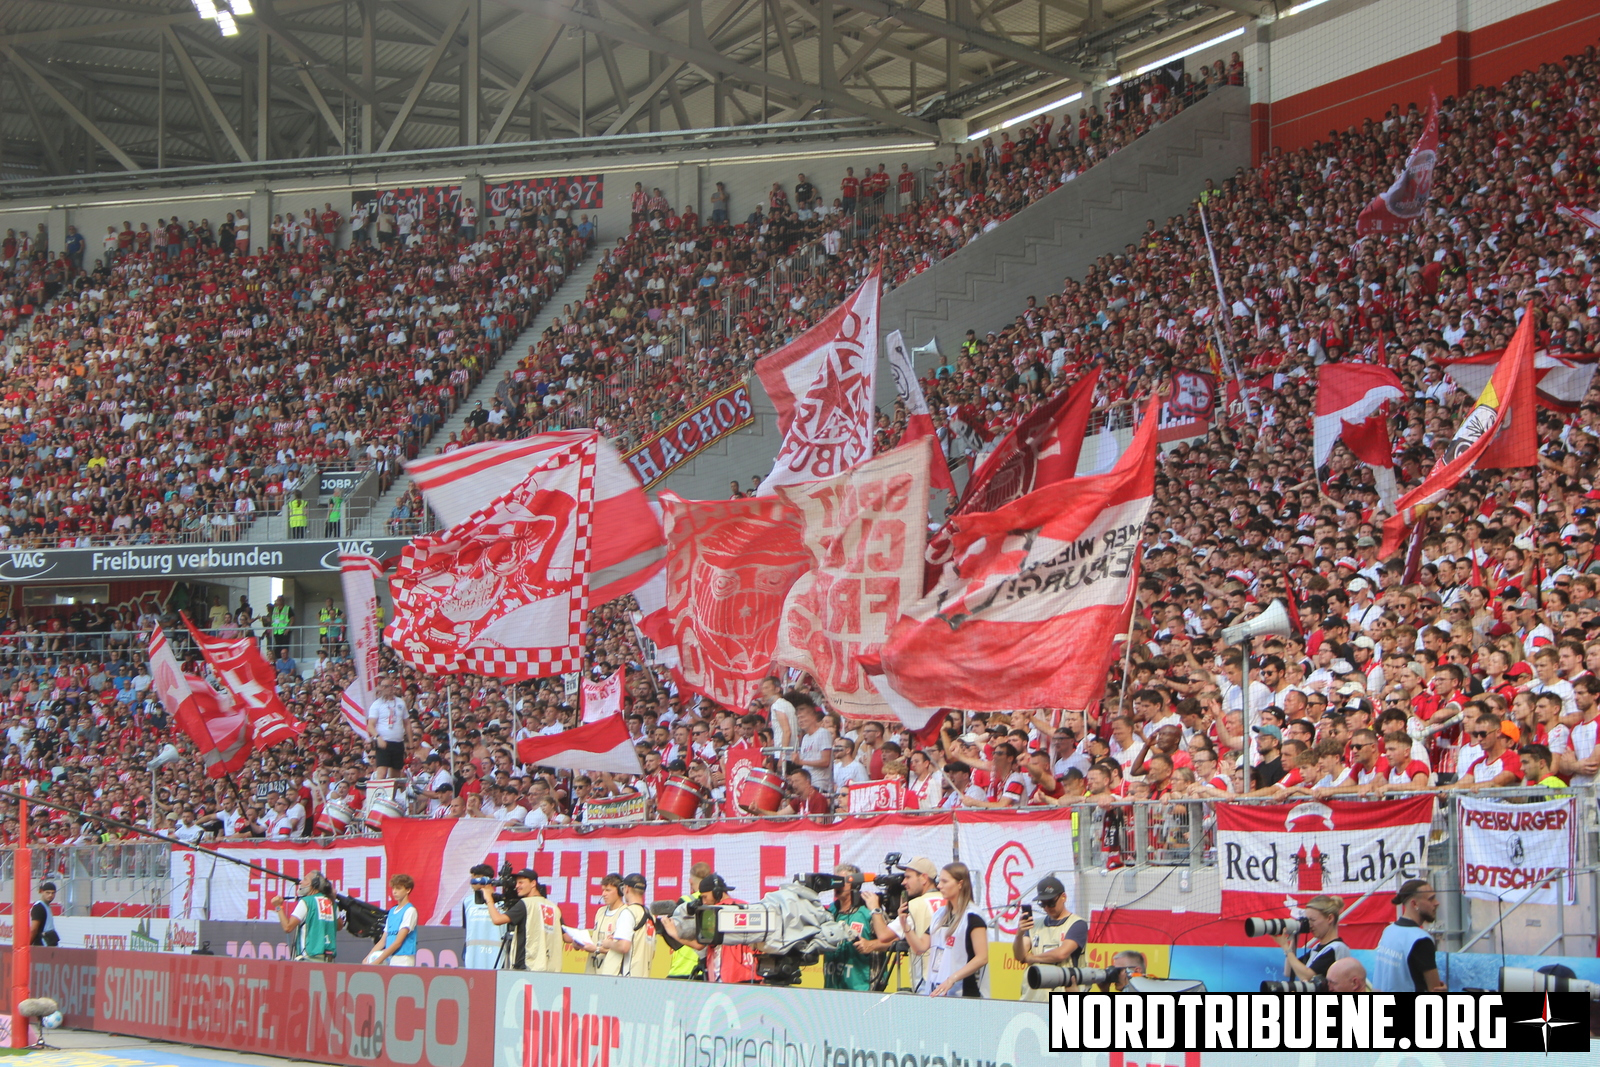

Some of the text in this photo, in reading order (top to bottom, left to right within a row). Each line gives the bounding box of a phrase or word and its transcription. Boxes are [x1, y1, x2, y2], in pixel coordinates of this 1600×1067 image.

[568, 181, 599, 206] 97
[11, 552, 46, 569] VAG
[92, 546, 283, 574] Freiburg verbunden
[337, 541, 375, 556] VAG
[1465, 809, 1568, 832] FREIBURGER
[1225, 836, 1426, 883] Red Label
[307, 968, 469, 1067] NOCO
